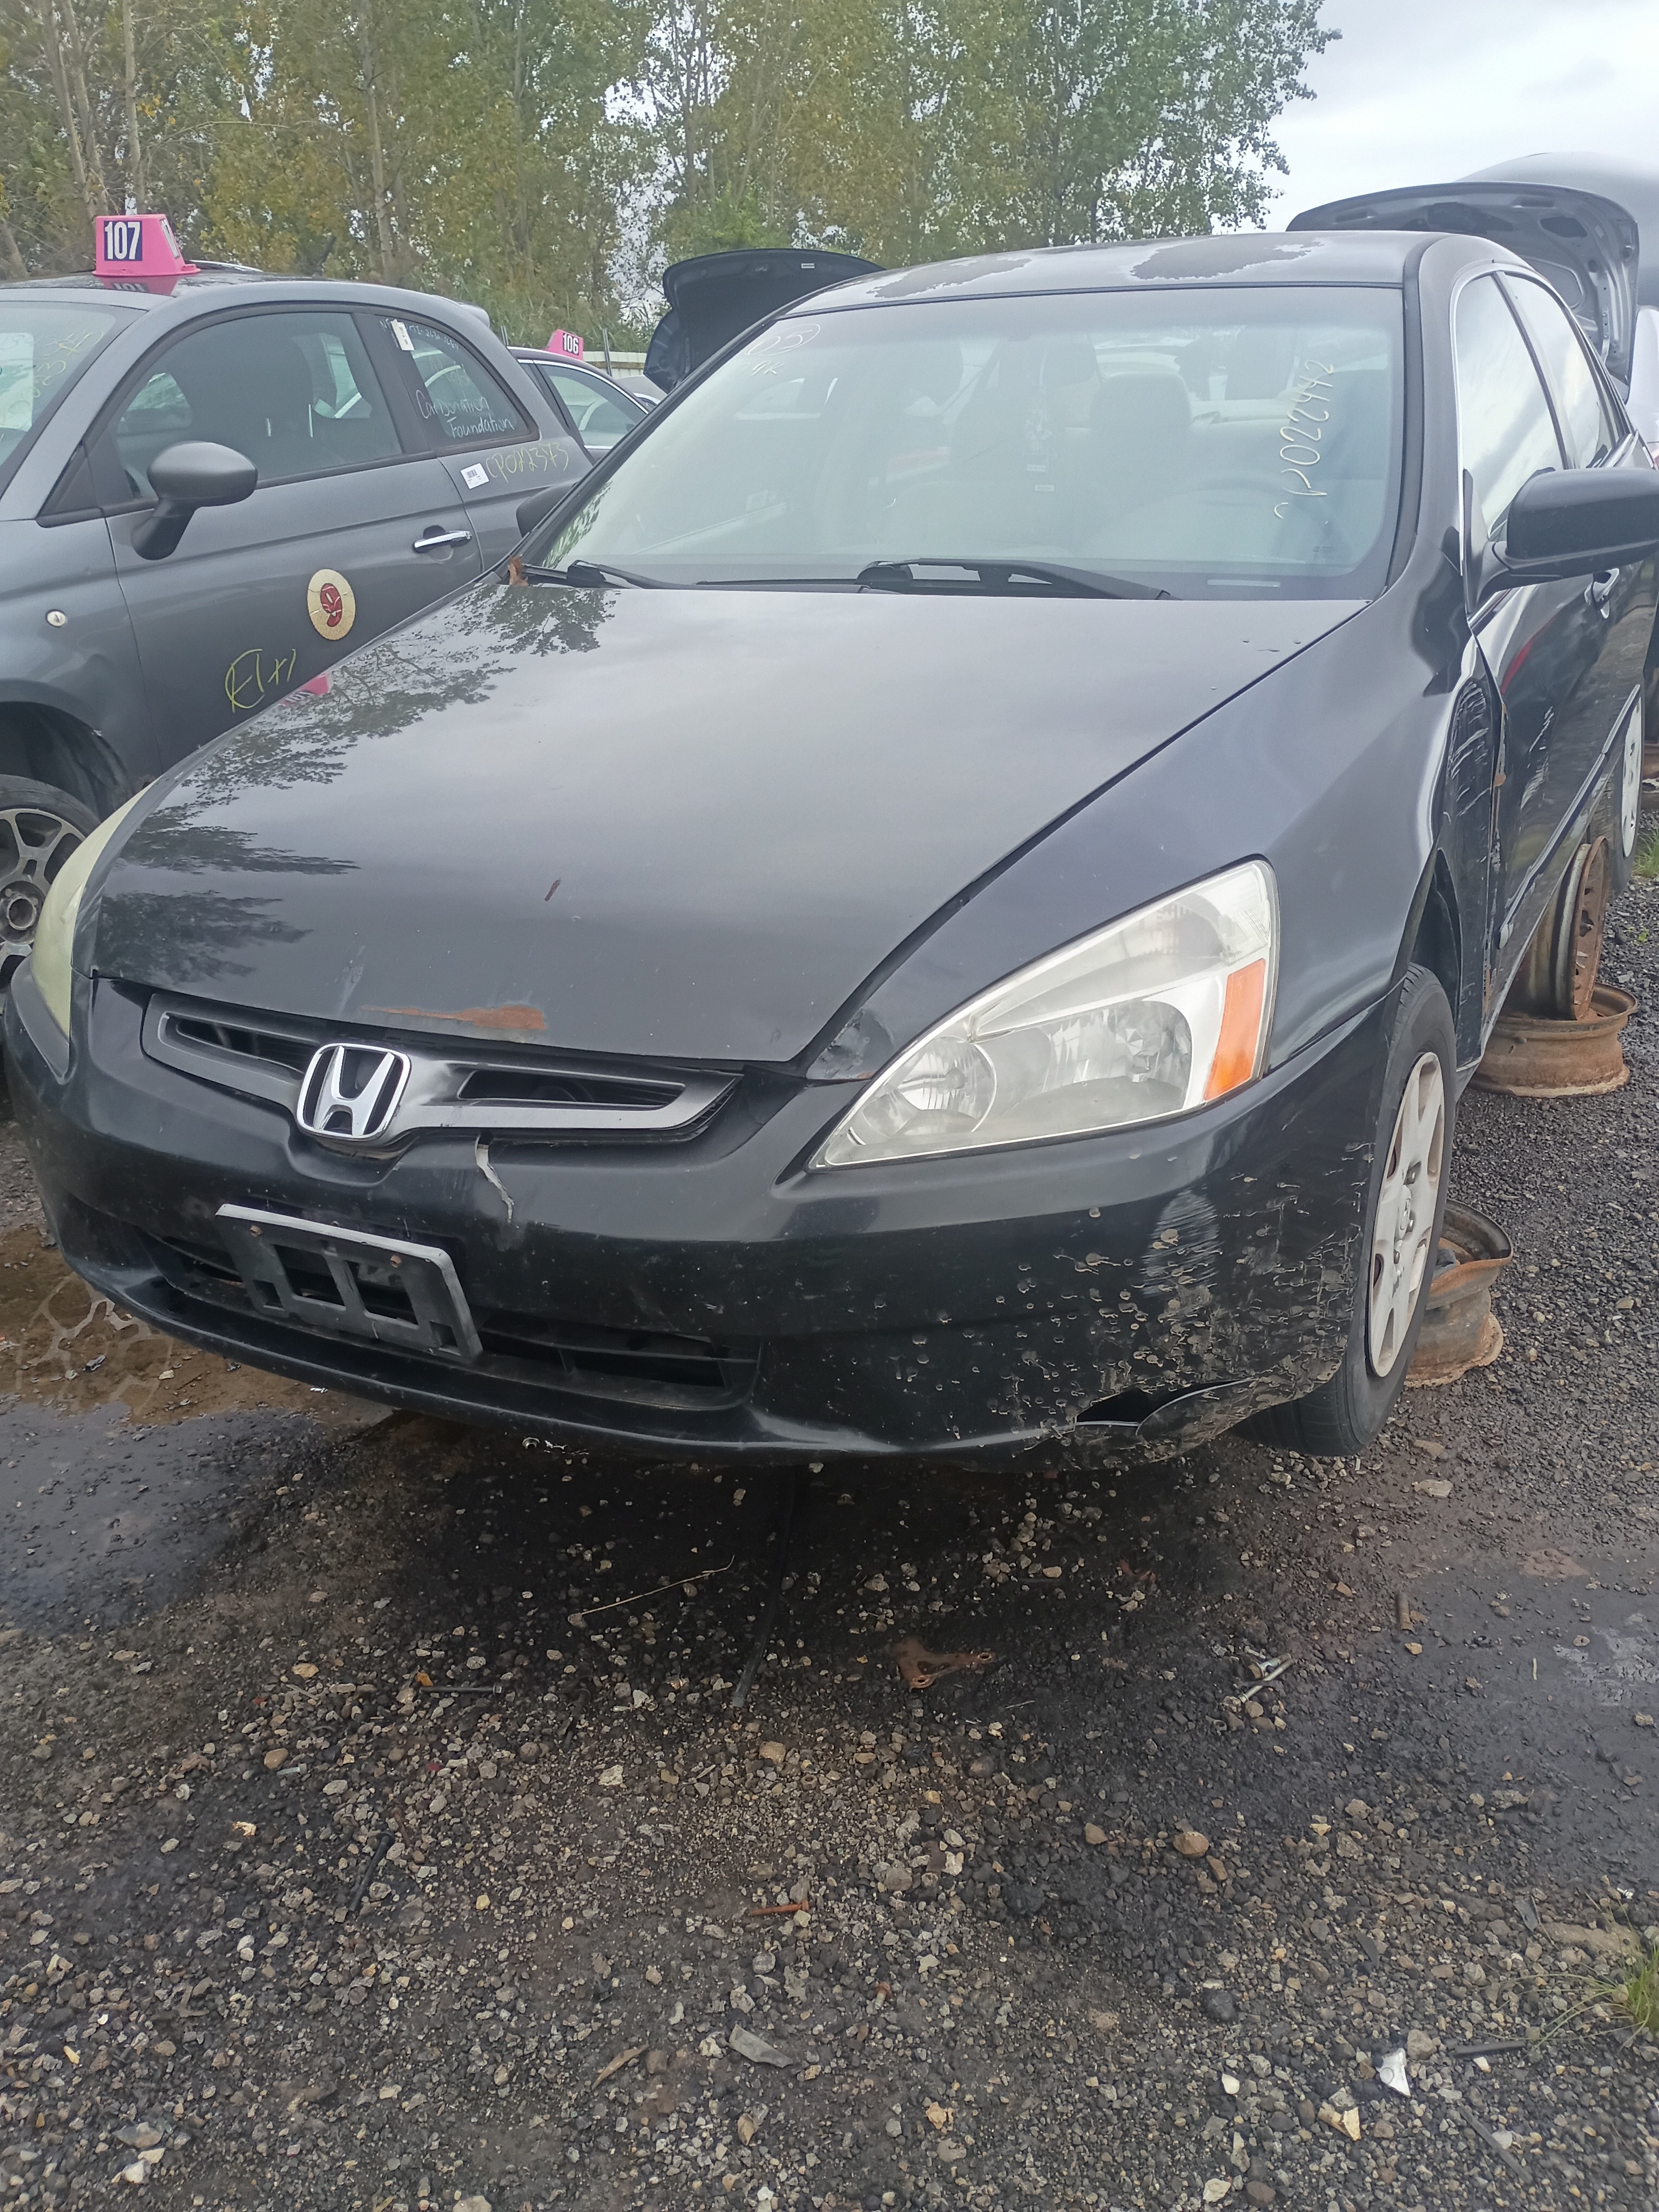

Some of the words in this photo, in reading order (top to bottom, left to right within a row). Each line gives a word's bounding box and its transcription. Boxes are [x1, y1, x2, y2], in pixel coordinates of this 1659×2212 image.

[105, 221, 140, 260] 107
[563, 333, 579, 354] 106
[447, 416, 515, 439] Foundation
